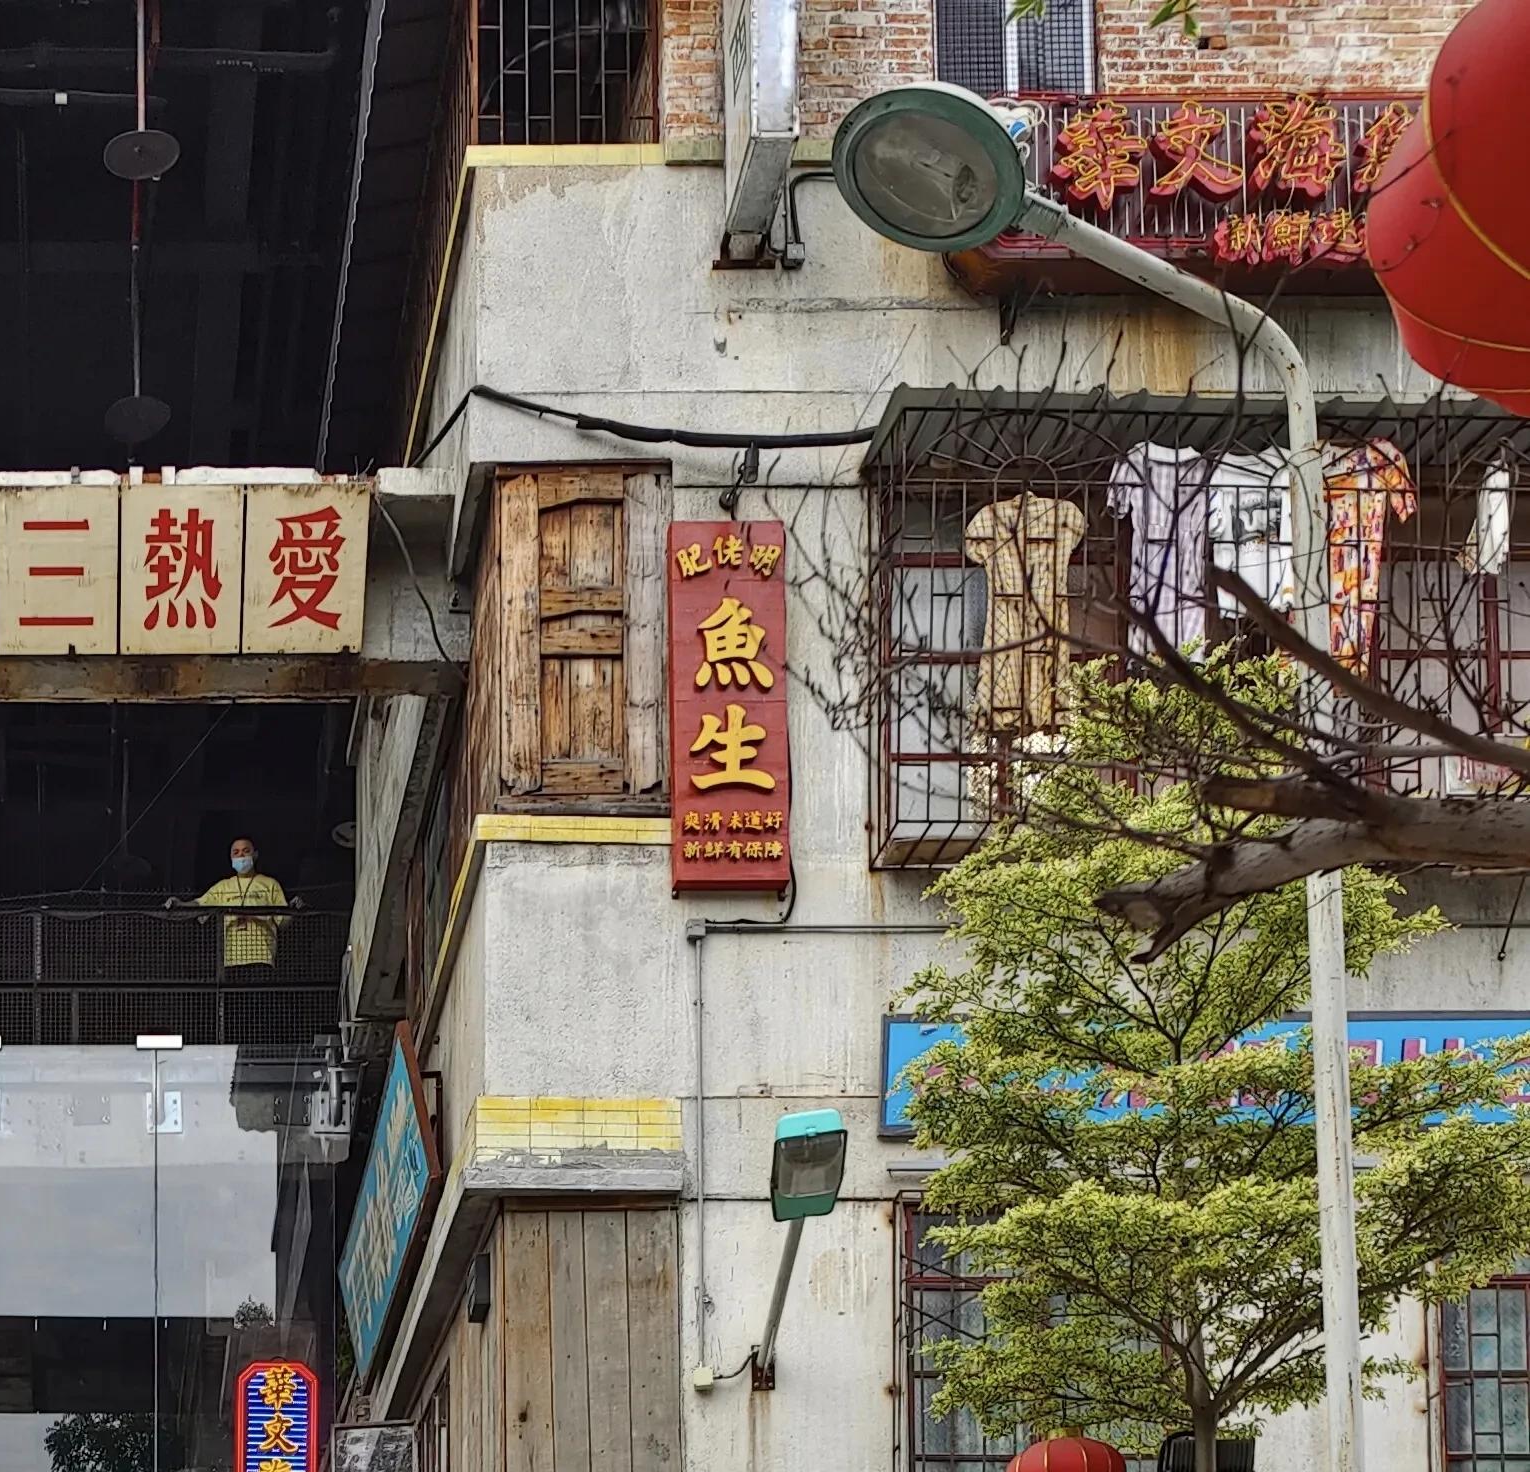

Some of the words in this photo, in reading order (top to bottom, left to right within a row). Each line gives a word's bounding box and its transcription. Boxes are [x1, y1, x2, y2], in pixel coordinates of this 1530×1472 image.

[676, 534, 782, 578] 肥佬明
[690, 597, 776, 791] 魚生
